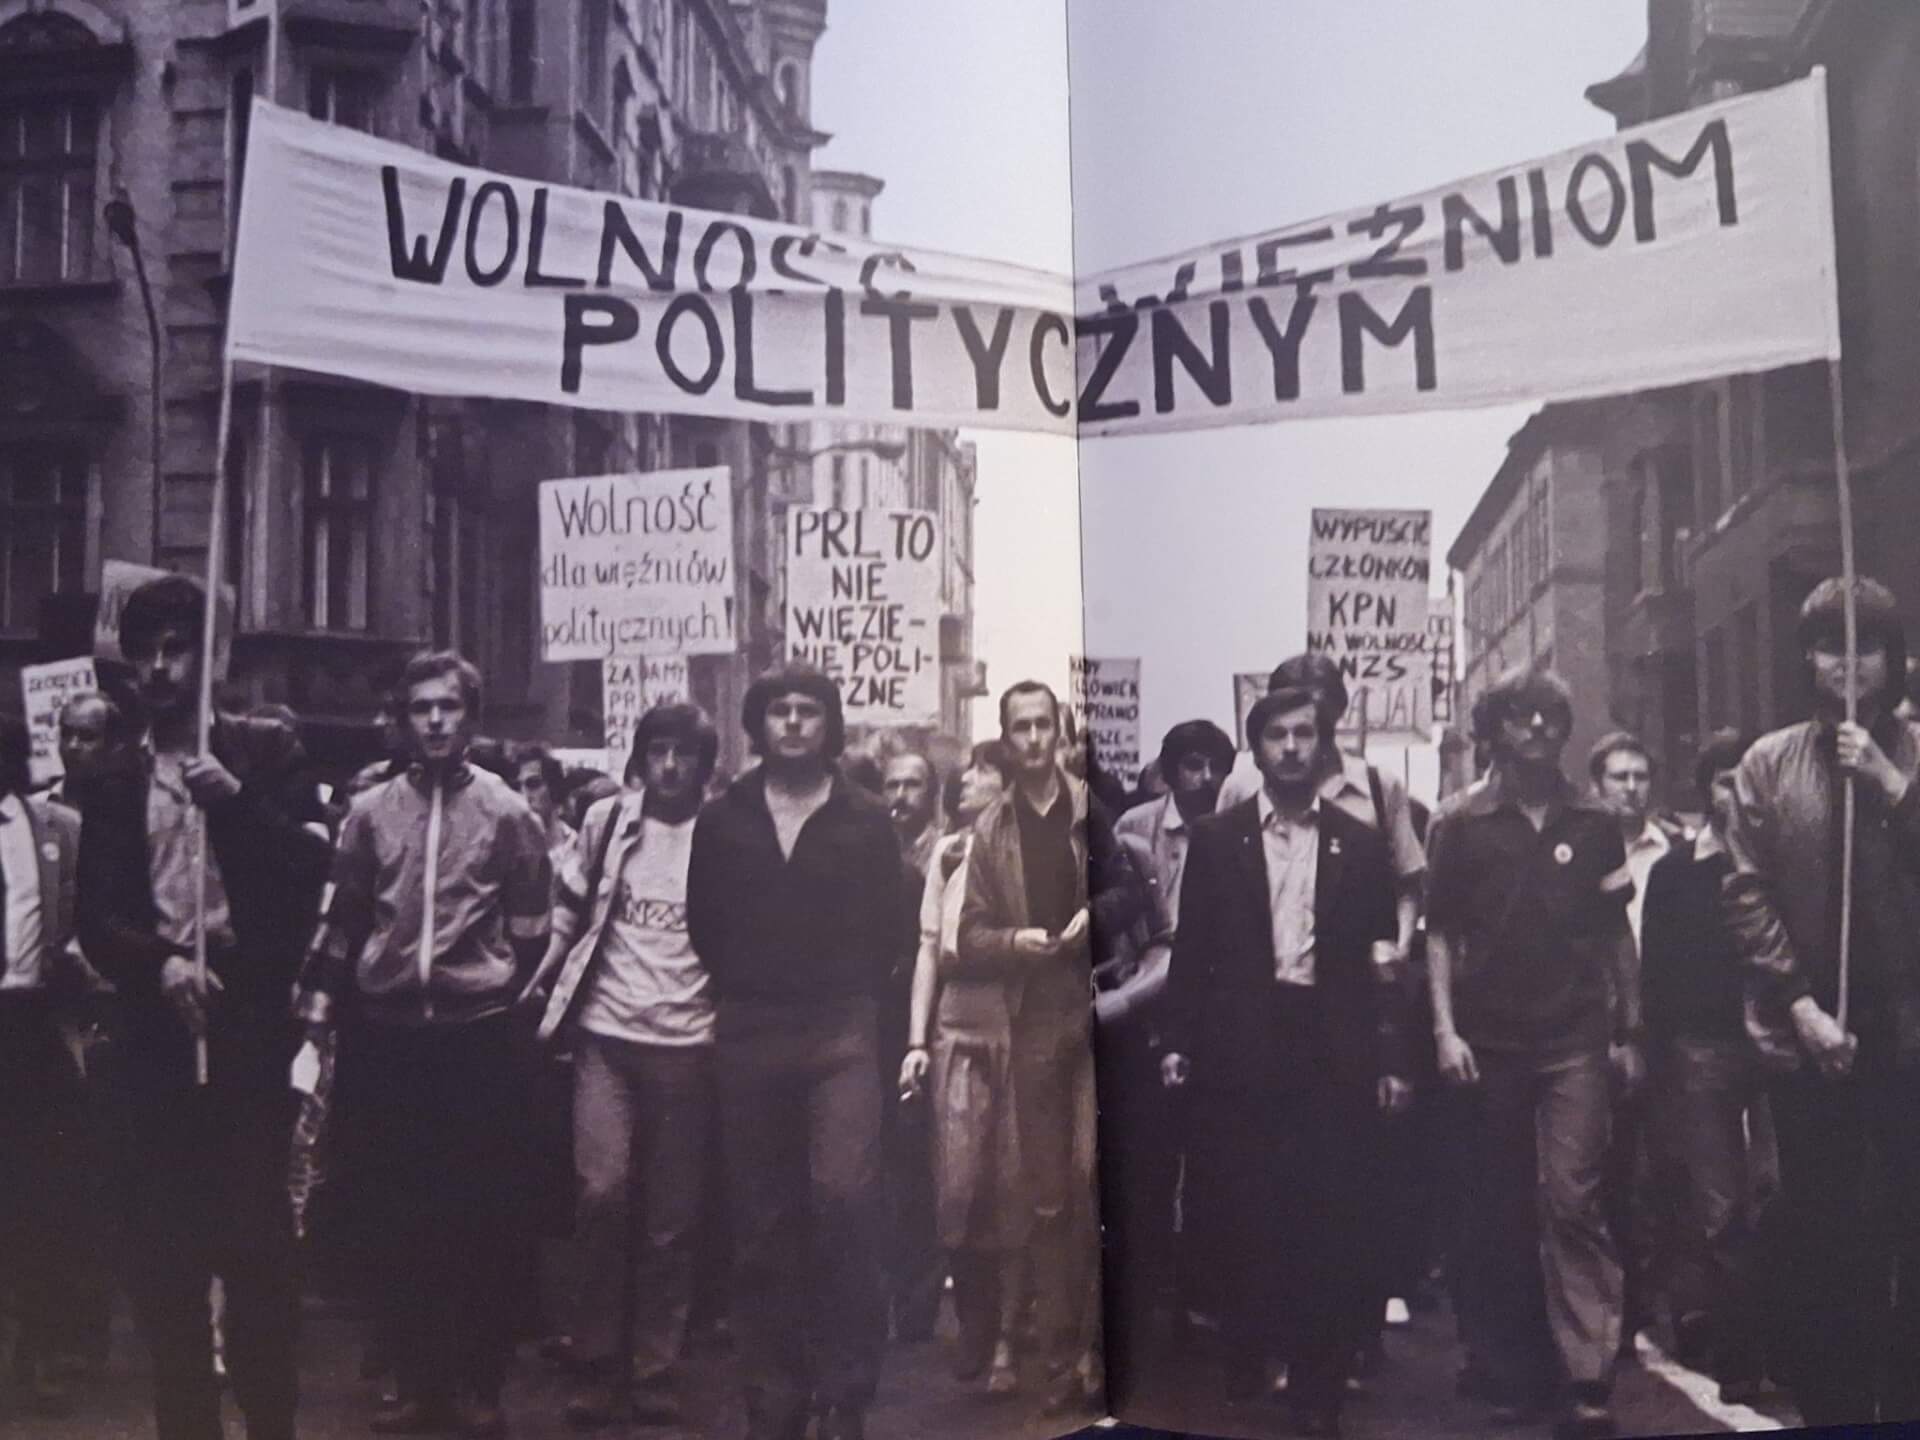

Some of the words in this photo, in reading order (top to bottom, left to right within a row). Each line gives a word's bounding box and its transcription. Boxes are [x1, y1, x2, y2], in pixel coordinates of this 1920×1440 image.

[561, 284, 1437, 422] POLITYCZNYM
[554, 480, 717, 538] Wolność
[795, 508, 881, 559] PRL
[889, 513, 935, 562] TO
[543, 552, 586, 588] dla
[595, 549, 727, 588] więźniów
[832, 562, 887, 601] NIE
[793, 604, 926, 645] WIĘZIE-
[1328, 592, 1396, 627] KPN
[853, 644, 933, 673] POLI-
[1308, 630, 1336, 651] NA
[1339, 655, 1406, 682] NZS
